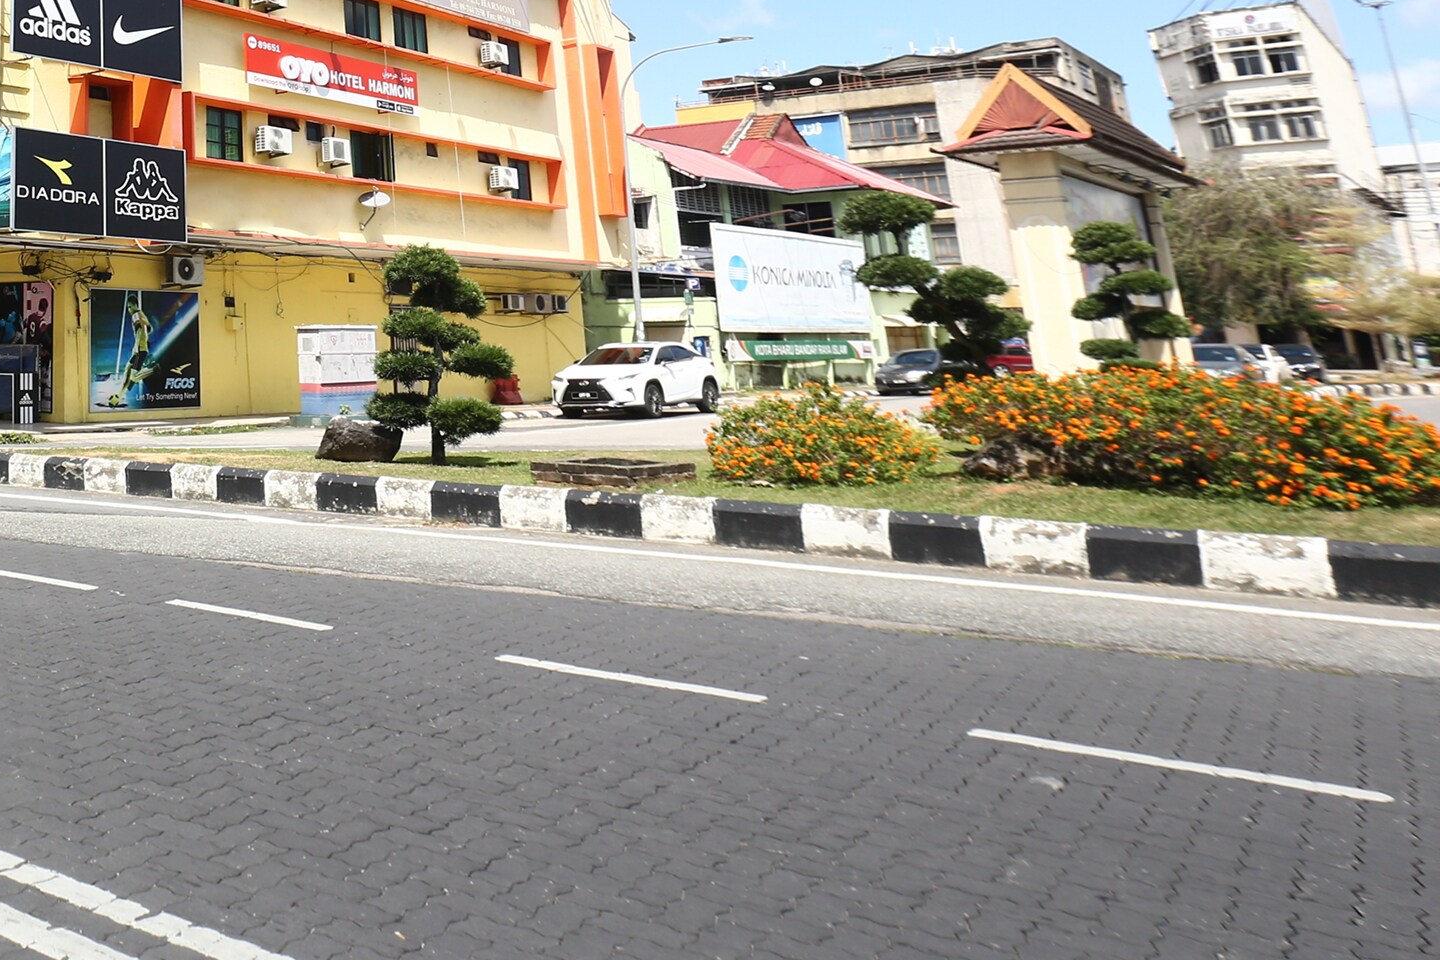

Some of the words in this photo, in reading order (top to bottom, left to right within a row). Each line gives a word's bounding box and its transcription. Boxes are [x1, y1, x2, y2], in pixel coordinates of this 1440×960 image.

[481, 0, 515, 16] HARMONI
[19, 16, 92, 46] adidas
[257, 40, 281, 53] 89651
[280, 55, 330, 86] OYO
[330, 69, 365, 90] HOTEL
[368, 79, 415, 100] HARMONI
[17, 185, 100, 206] DIADORA
[115, 198, 179, 221] Kappa
[688, 279, 698, 289] P
[752, 265, 795, 287] KONICA
[796, 268, 837, 289] MINOLTA
[754, 344, 772, 356] KOTA
[772, 344, 794, 356] BHARU
[146, 393, 154, 401] Try
[155, 392, 183, 401] Something
